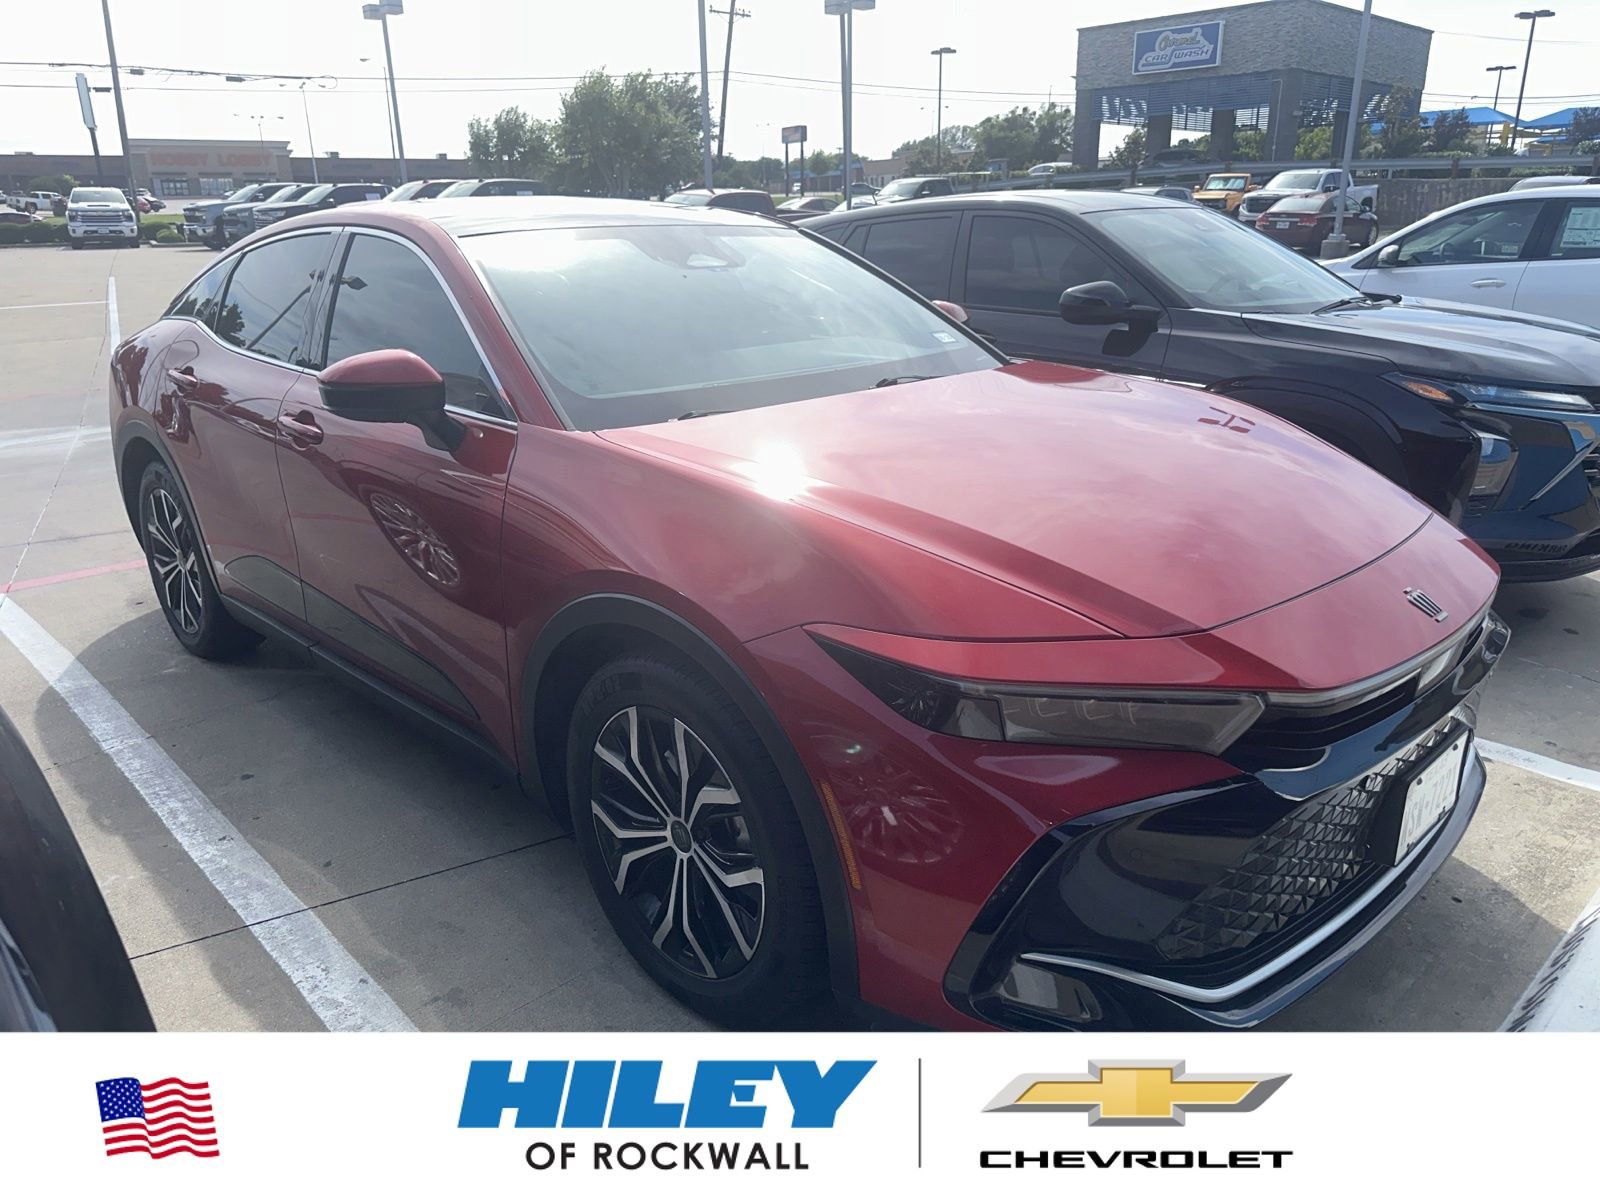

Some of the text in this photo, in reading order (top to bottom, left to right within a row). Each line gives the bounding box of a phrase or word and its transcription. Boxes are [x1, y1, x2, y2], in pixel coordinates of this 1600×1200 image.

[1144, 48, 1209, 63] CAR WASH
[217, 153, 272, 167] LOBBY
